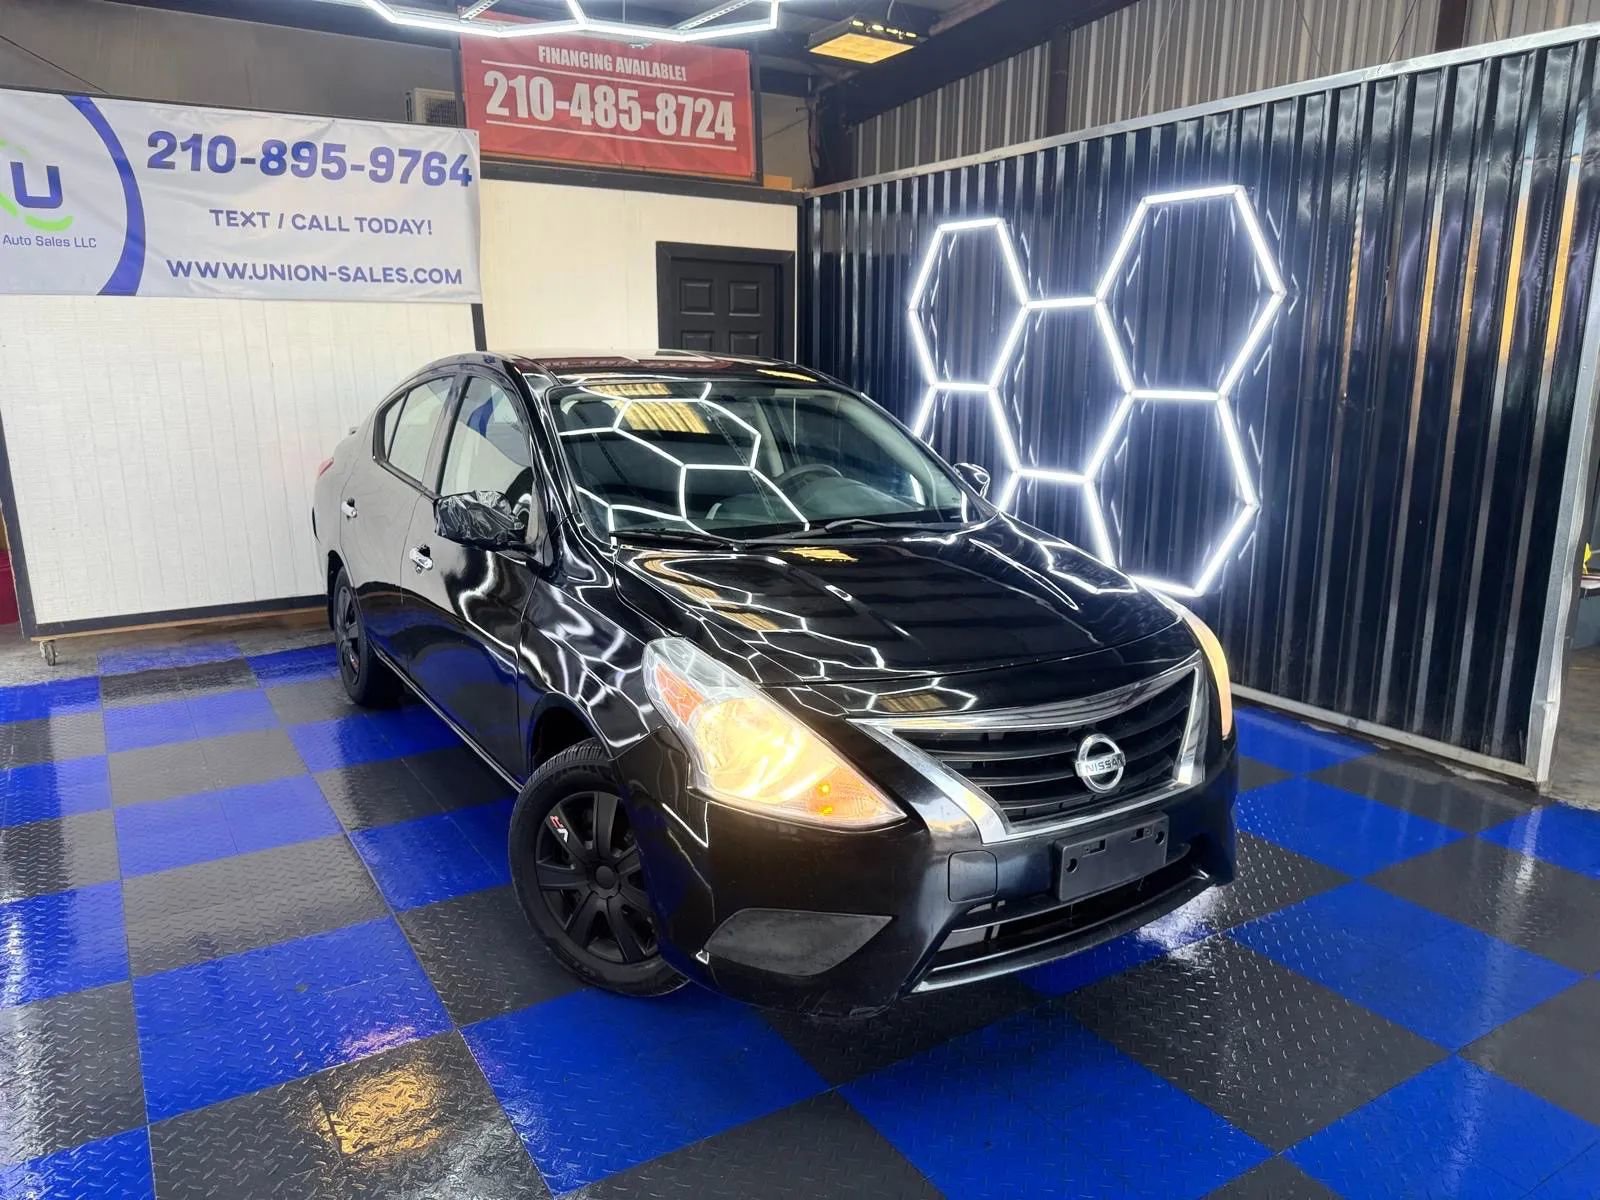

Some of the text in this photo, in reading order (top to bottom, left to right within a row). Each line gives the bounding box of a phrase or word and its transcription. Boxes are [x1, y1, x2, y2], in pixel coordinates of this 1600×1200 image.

[538, 45, 687, 81] FINANCING AVAILABLE!
[483, 70, 736, 141] 210-485-8724
[147, 130, 473, 187] 210-895-9764
[209, 209, 433, 235] TEXT / CALL TODAY!
[3, 234, 97, 248] Auto Sales LLC
[166, 259, 463, 285] WWW.UNION-SALES.COM
[1085, 755, 1124, 773] NISSAN
